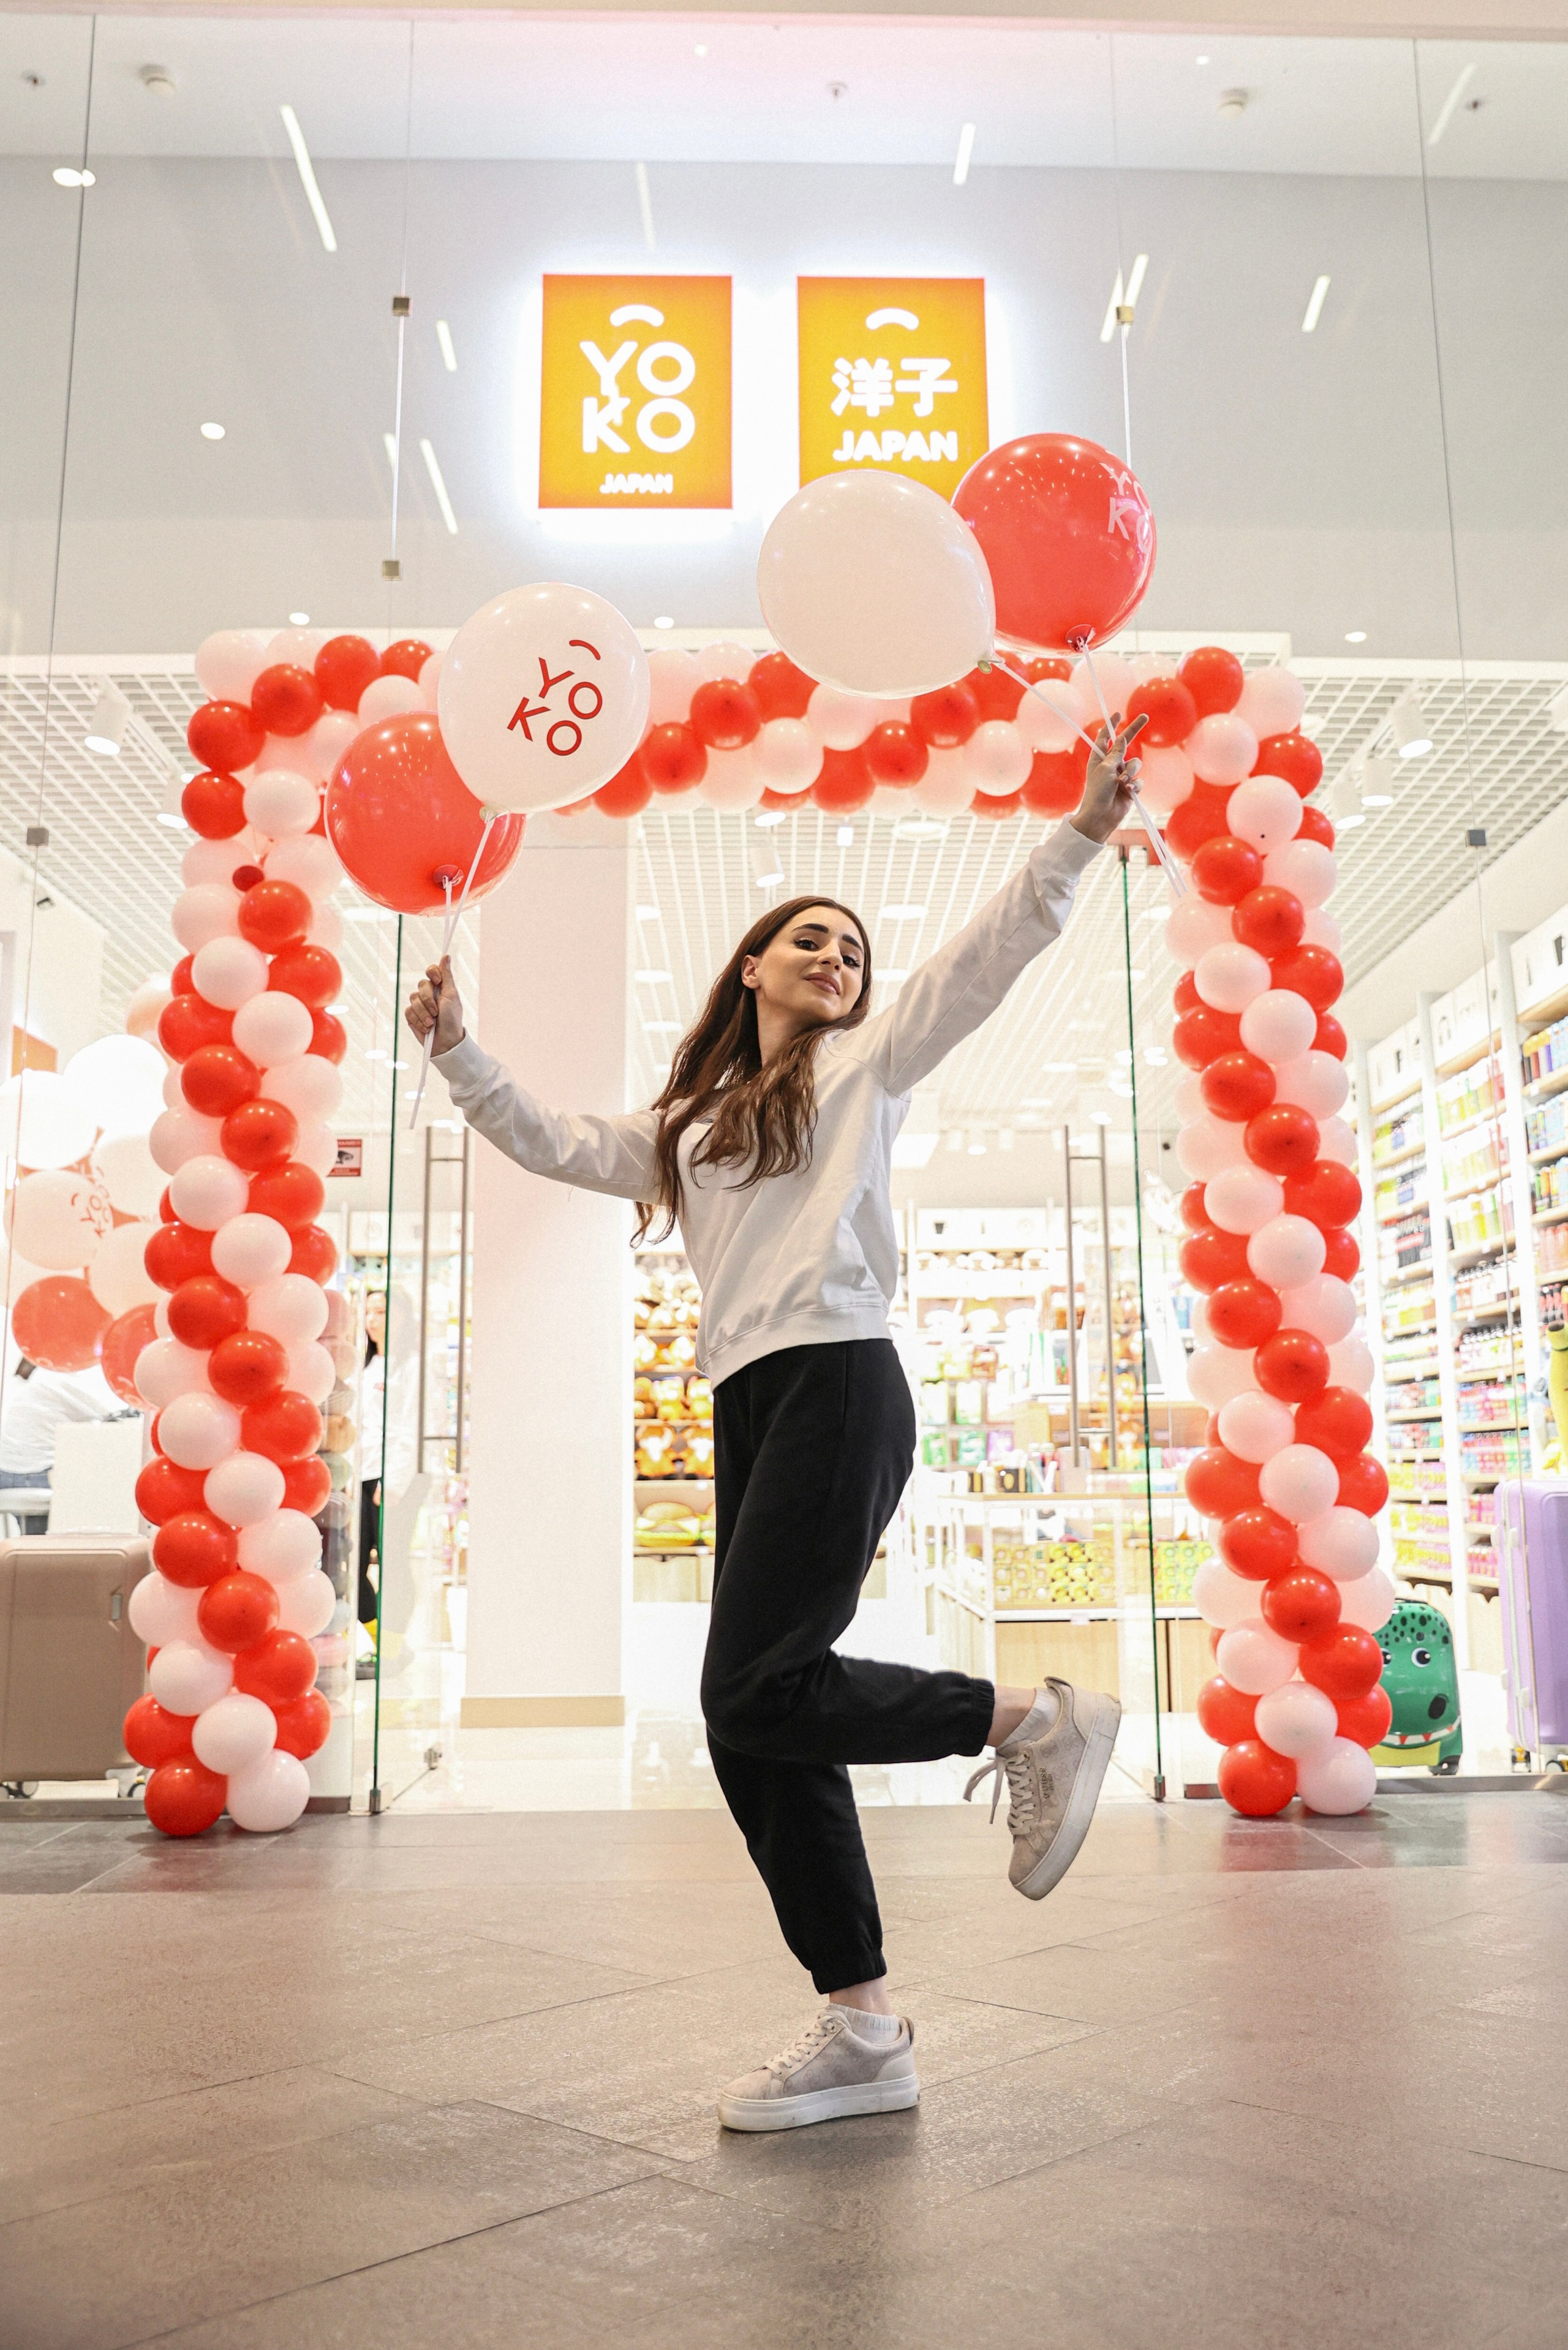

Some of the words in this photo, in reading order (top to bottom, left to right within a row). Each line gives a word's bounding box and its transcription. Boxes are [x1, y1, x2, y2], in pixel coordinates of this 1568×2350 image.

[579, 341, 695, 396] YO
[831, 357, 959, 417] 洋子
[833, 429, 958, 461] JAPAN
[599, 473, 673, 494] JAPAN
[538, 657, 603, 720] YO
[507, 697, 582, 756] KO
[1039, 1767, 1049, 1798] GUESS
